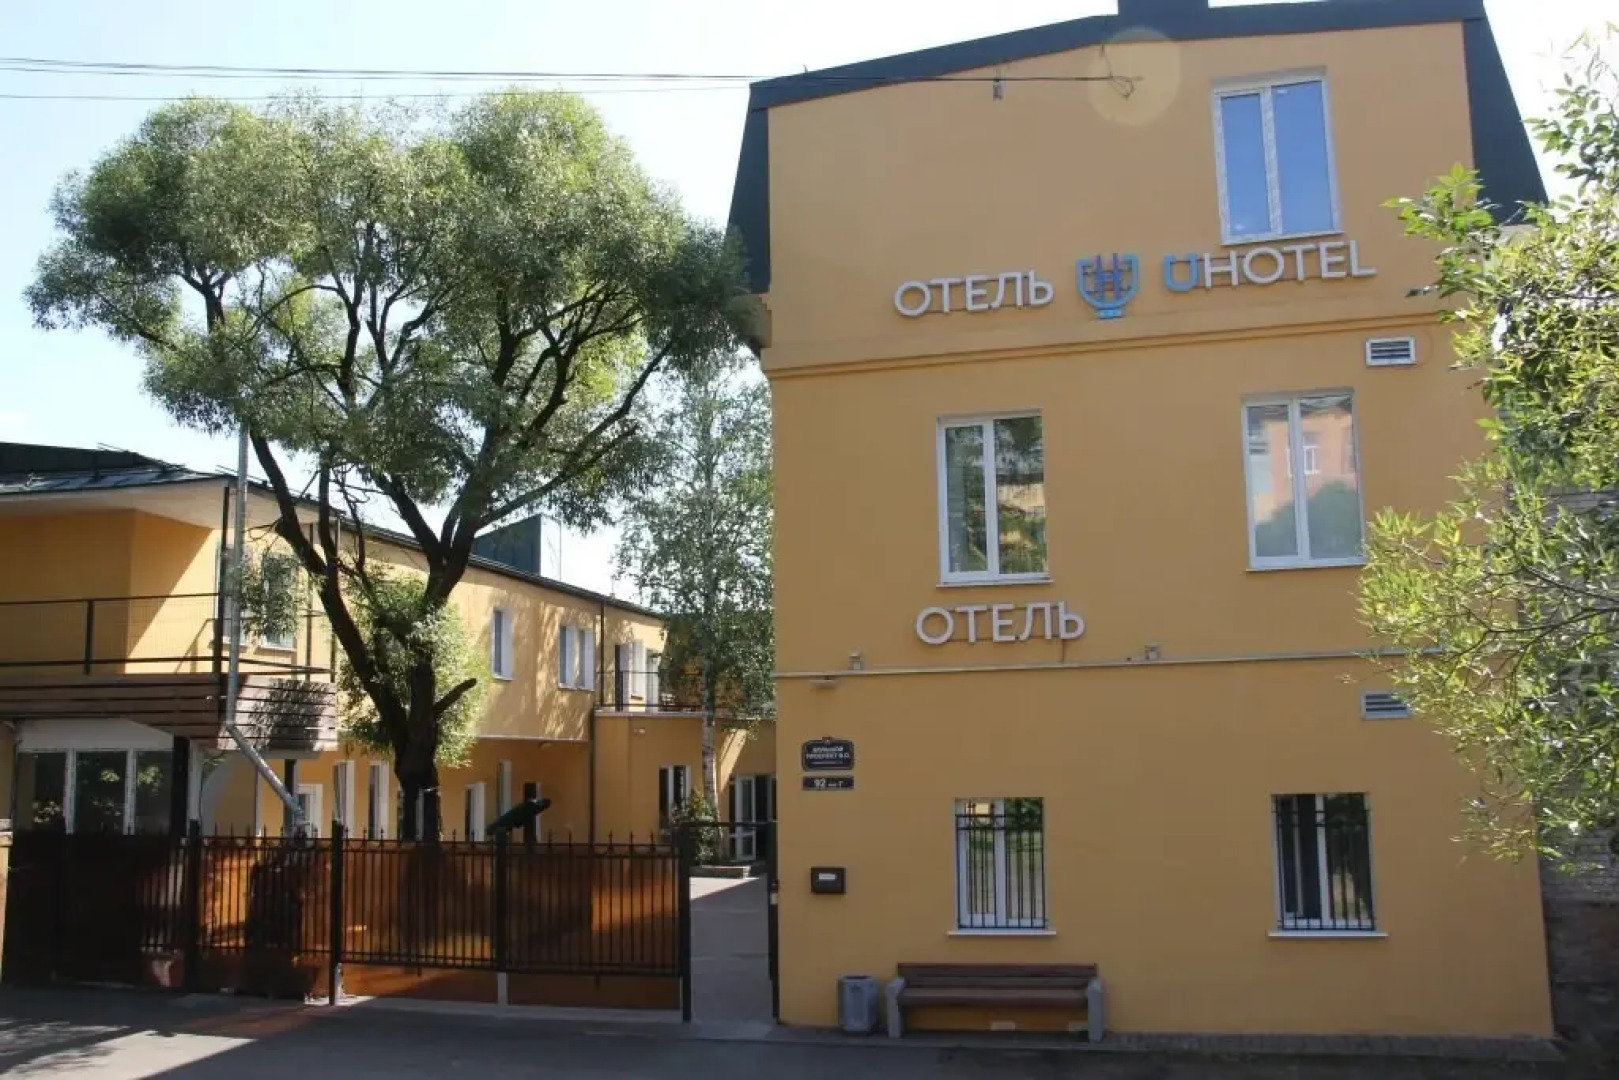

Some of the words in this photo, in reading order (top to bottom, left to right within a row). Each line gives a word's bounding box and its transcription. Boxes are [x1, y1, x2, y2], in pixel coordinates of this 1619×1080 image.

[894, 269, 1054, 317] ОТЕЛЬ
[1162, 239, 1378, 293] UHOTEL
[915, 601, 1086, 645] ОТЕЛЬ
